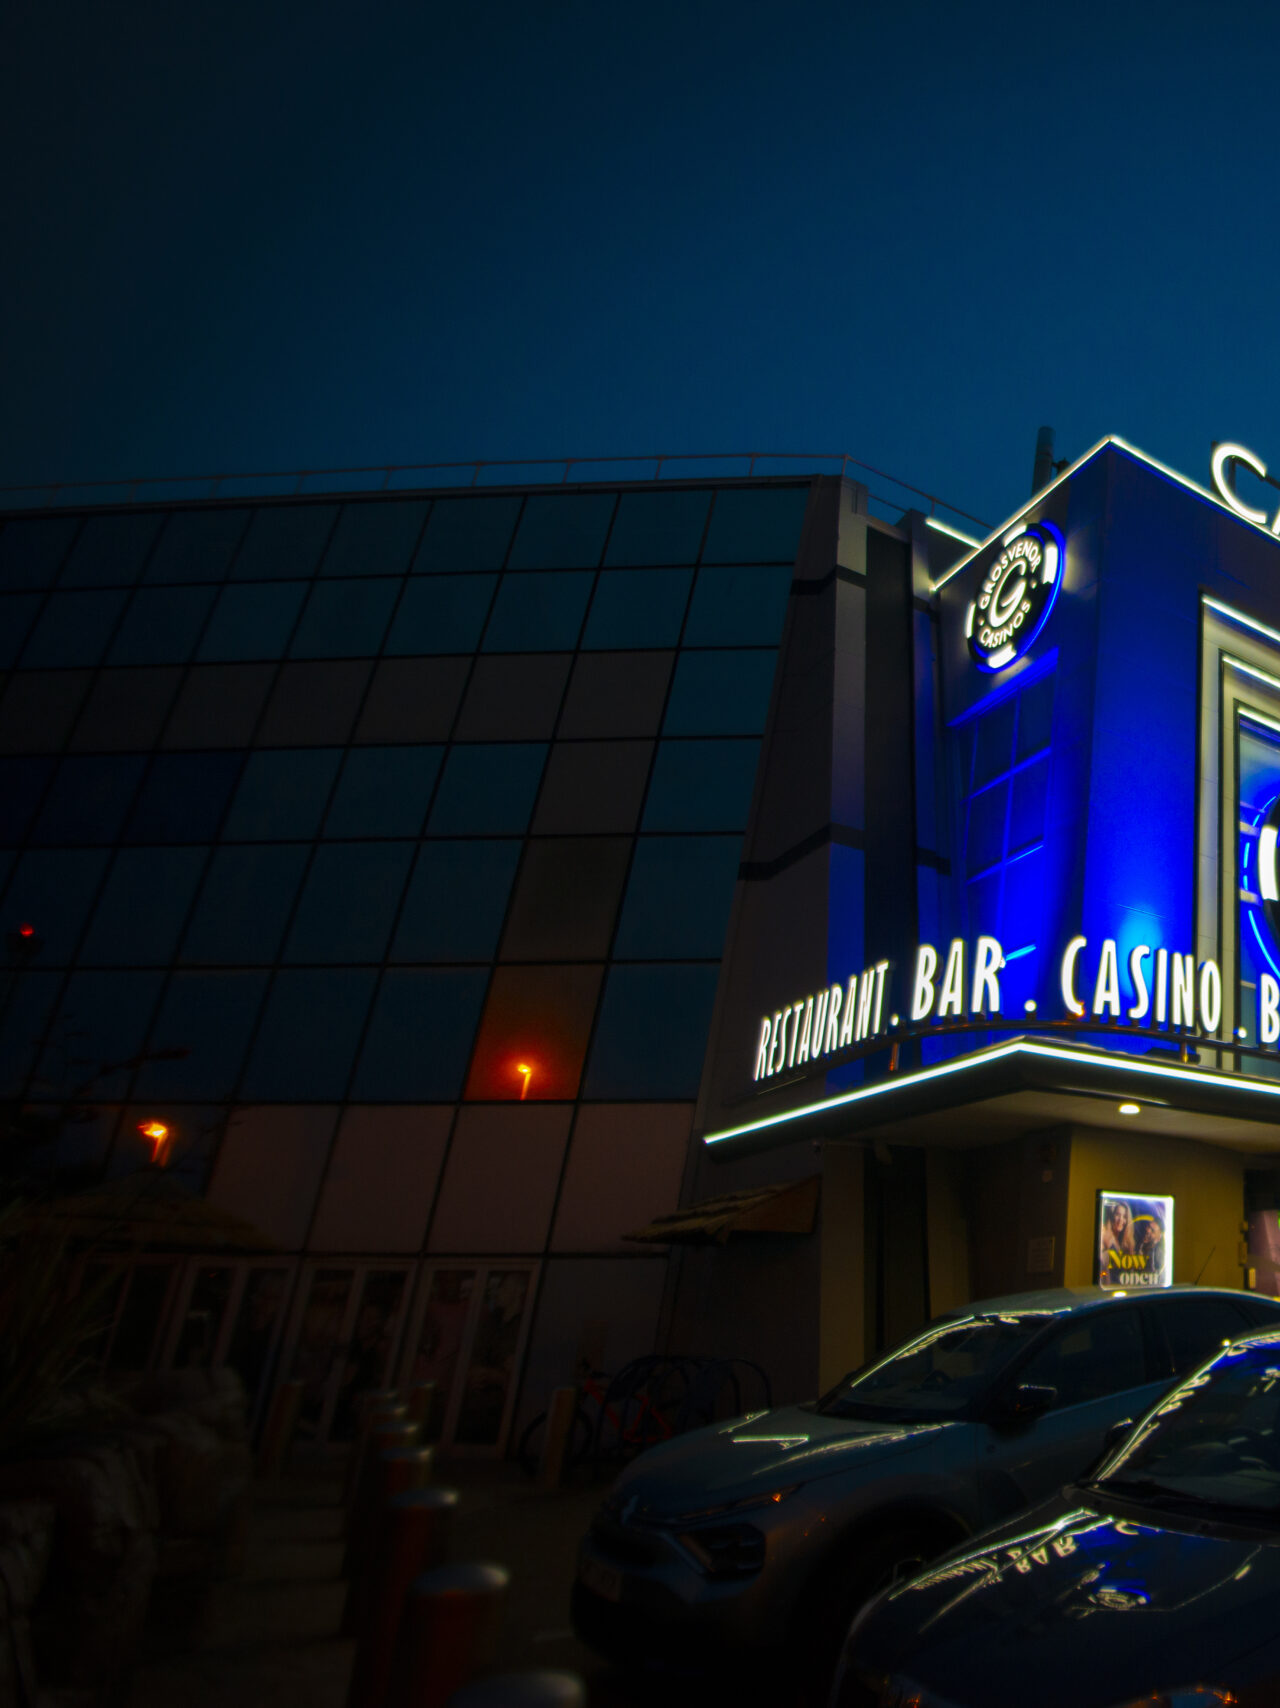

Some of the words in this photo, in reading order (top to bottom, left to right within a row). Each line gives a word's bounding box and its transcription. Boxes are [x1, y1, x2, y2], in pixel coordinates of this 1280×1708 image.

[978, 541, 1041, 610] GROSVENOR
[989, 558, 1027, 628] G
[979, 601, 1031, 648] CASINOS
[754, 959, 890, 1081] RESTAURANT
[911, 935, 1004, 1021] BAR
[1061, 935, 1222, 1032] CASINO
